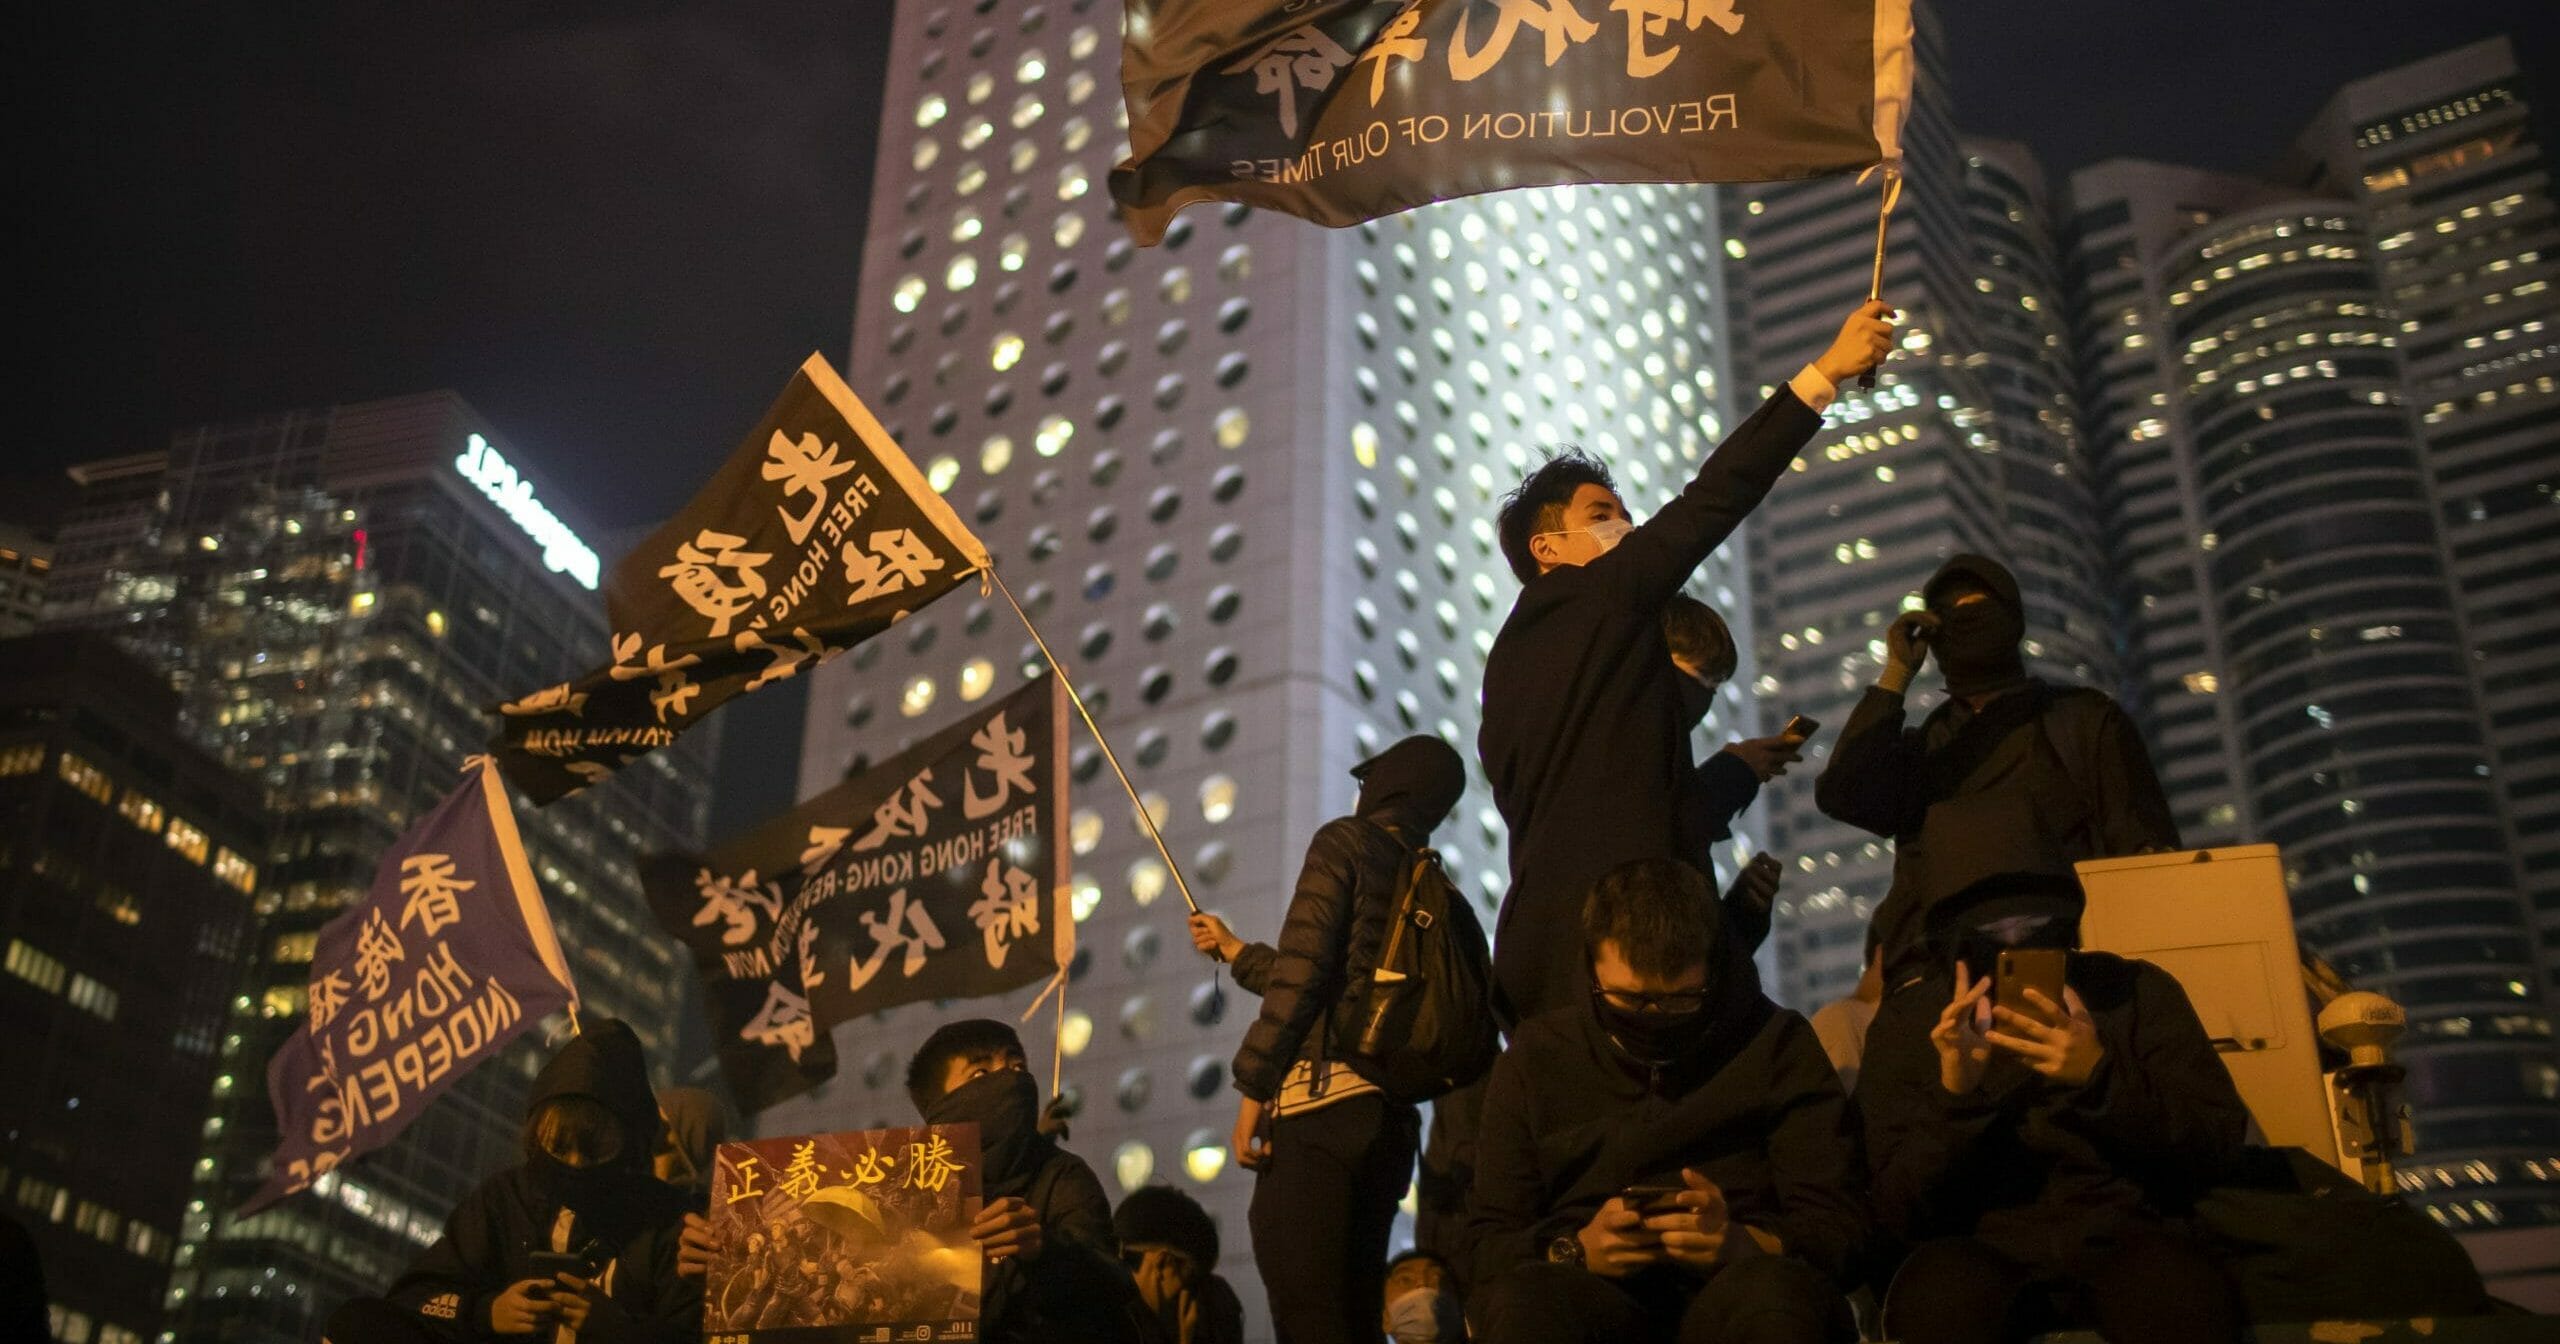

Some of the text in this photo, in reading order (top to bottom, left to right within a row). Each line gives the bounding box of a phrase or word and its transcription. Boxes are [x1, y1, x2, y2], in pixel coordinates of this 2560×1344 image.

[726, 1133, 966, 1205] 正義必勝
[422, 1304, 456, 1318] adidas
